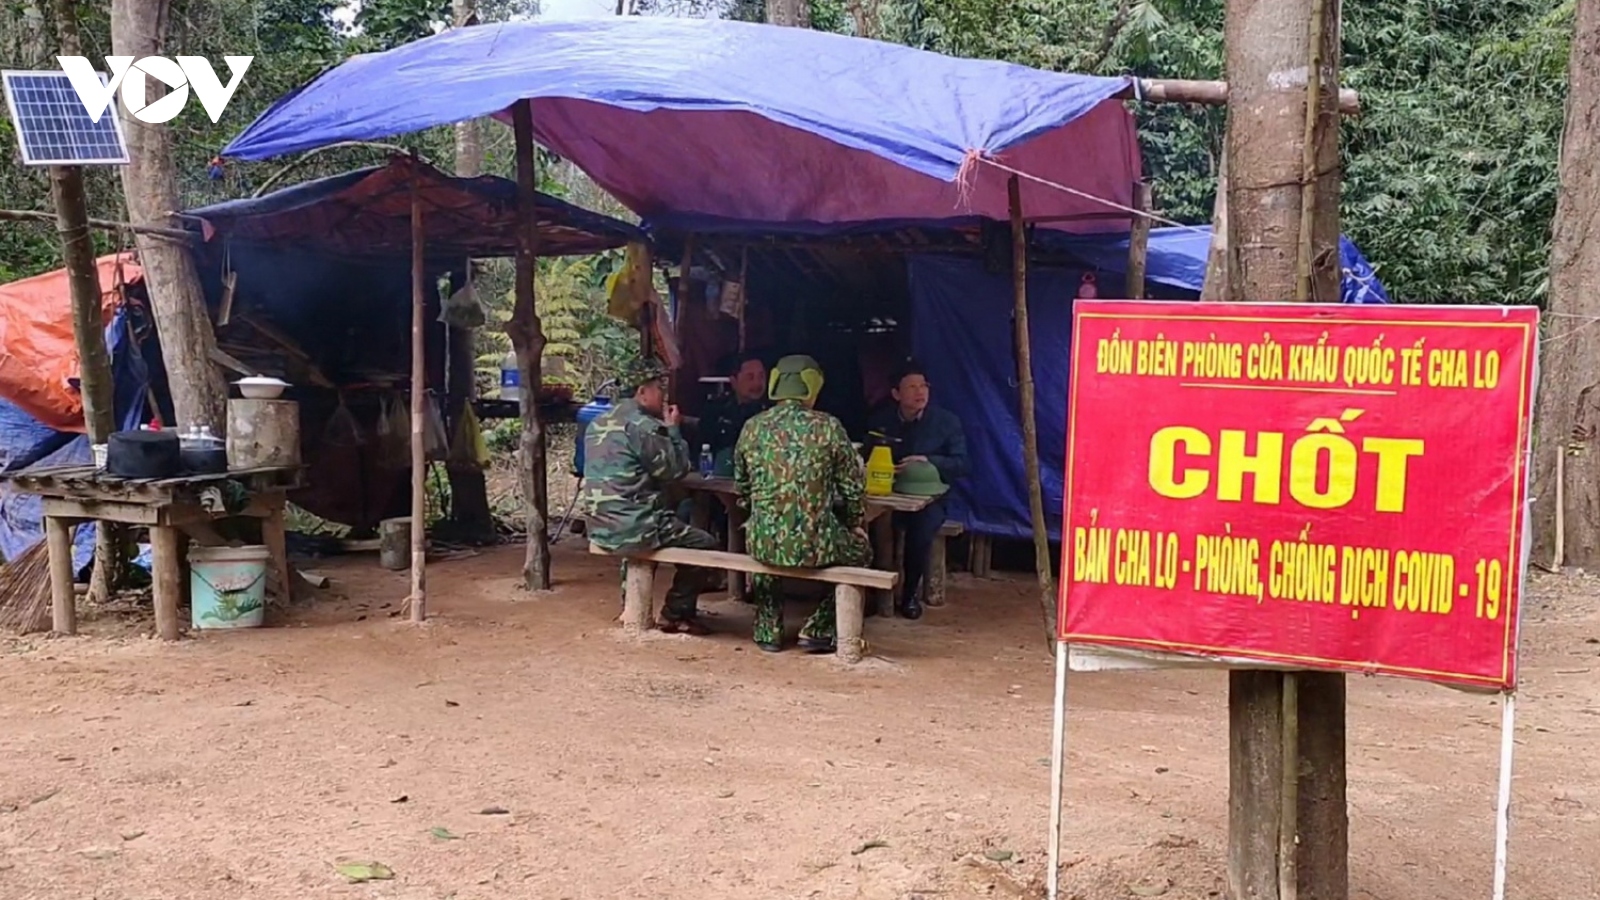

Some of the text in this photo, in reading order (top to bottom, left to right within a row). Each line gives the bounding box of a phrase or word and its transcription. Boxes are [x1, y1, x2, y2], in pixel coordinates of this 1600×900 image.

[1136, 333, 1178, 376] BIÊN
[1181, 333, 1243, 378] PHÒNG
[1246, 332, 1283, 380] CỬA
[1288, 331, 1340, 383] KHẨU
[1343, 333, 1396, 388] QUỐC
[1401, 337, 1426, 386] TẾ
[1427, 349, 1469, 388] CHA
[1473, 350, 1500, 389] LO
[1147, 408, 1425, 513] CHỐT
[1074, 508, 1112, 584] BẢN
[1114, 528, 1151, 586] CHA
[1154, 531, 1179, 590] LO
[1194, 522, 1264, 605] PHÒNG,
[1268, 522, 1337, 604] CHỐNG
[1340, 546, 1390, 620] DỊCH
[1393, 550, 1455, 614] COVID
[1475, 558, 1502, 620] 19
